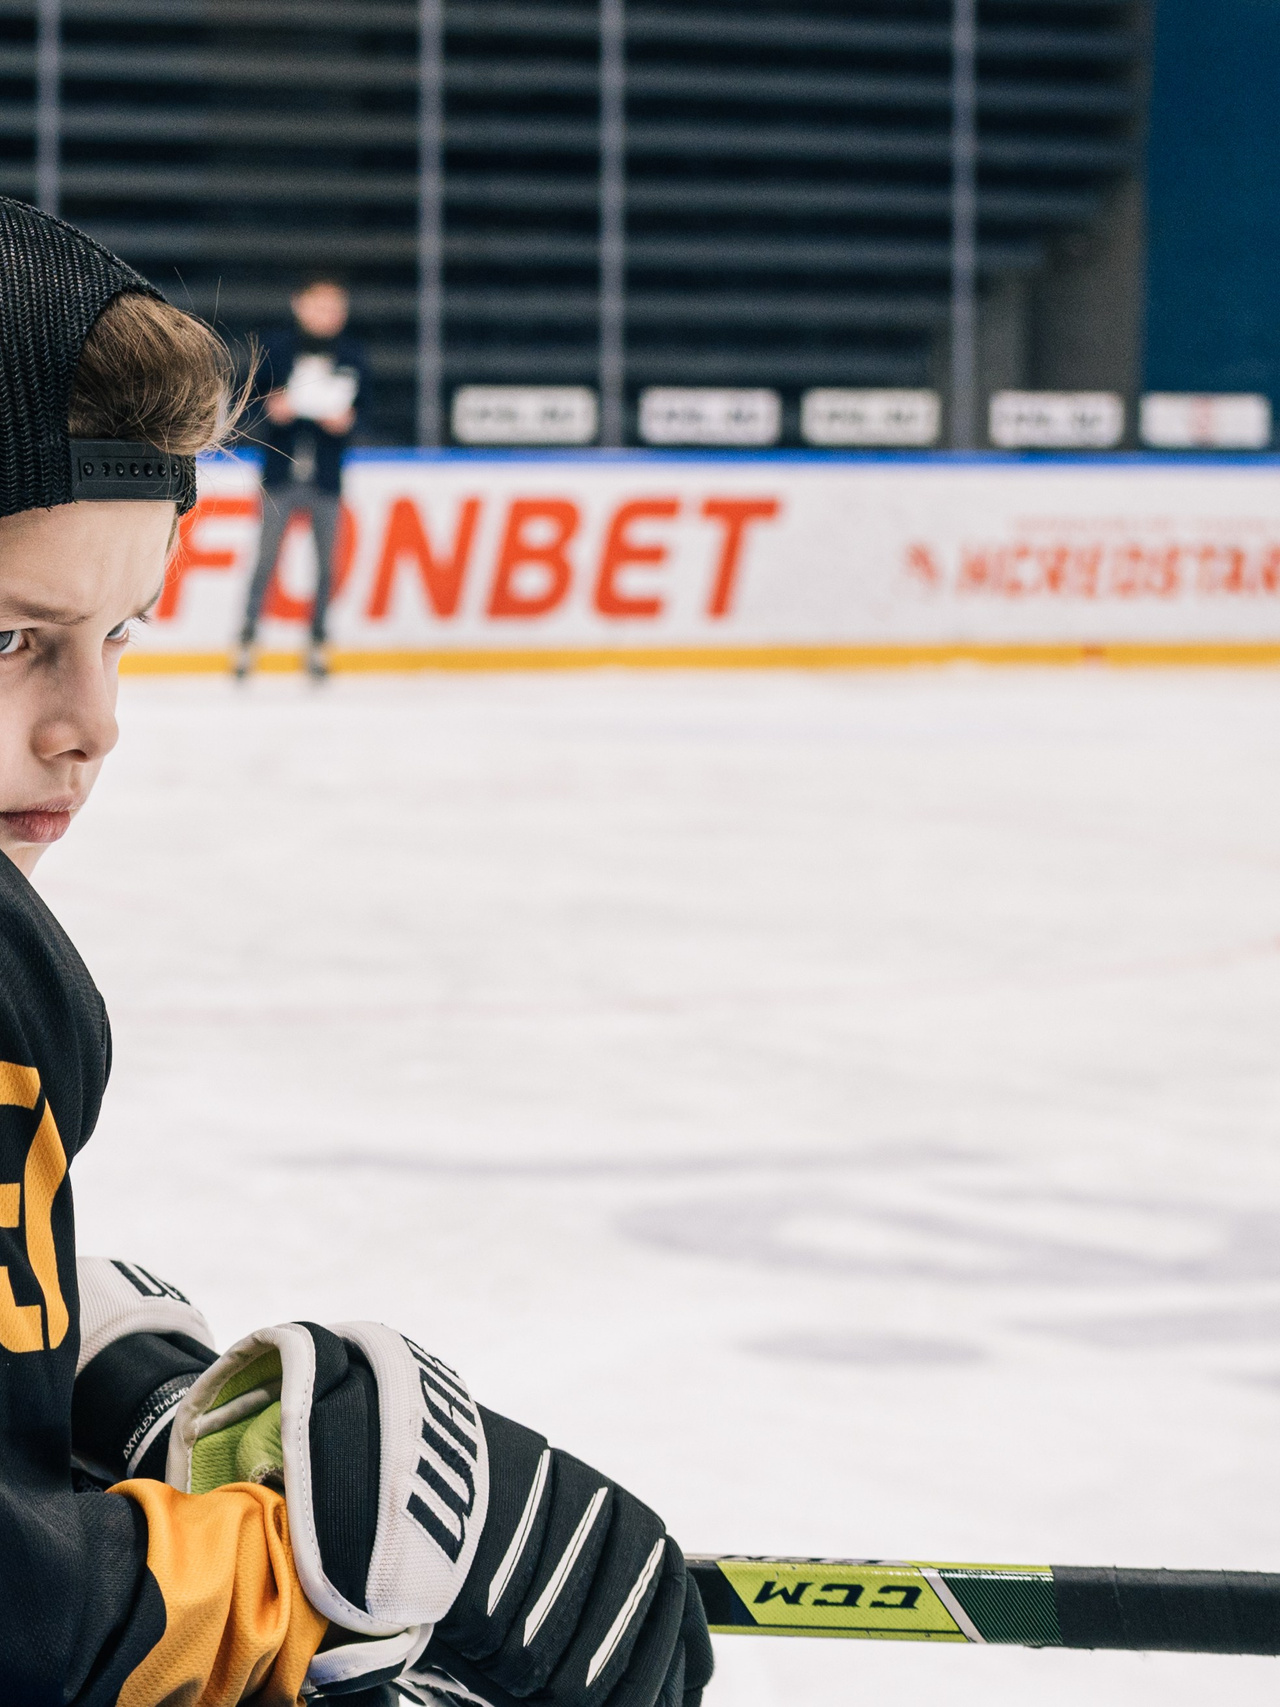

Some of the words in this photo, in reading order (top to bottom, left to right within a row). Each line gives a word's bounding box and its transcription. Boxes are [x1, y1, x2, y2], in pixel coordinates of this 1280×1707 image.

[156, 494, 780, 620] FONBET
[122, 1412, 156, 1461] AXYFLEX
[753, 1579, 924, 1611] CCM
